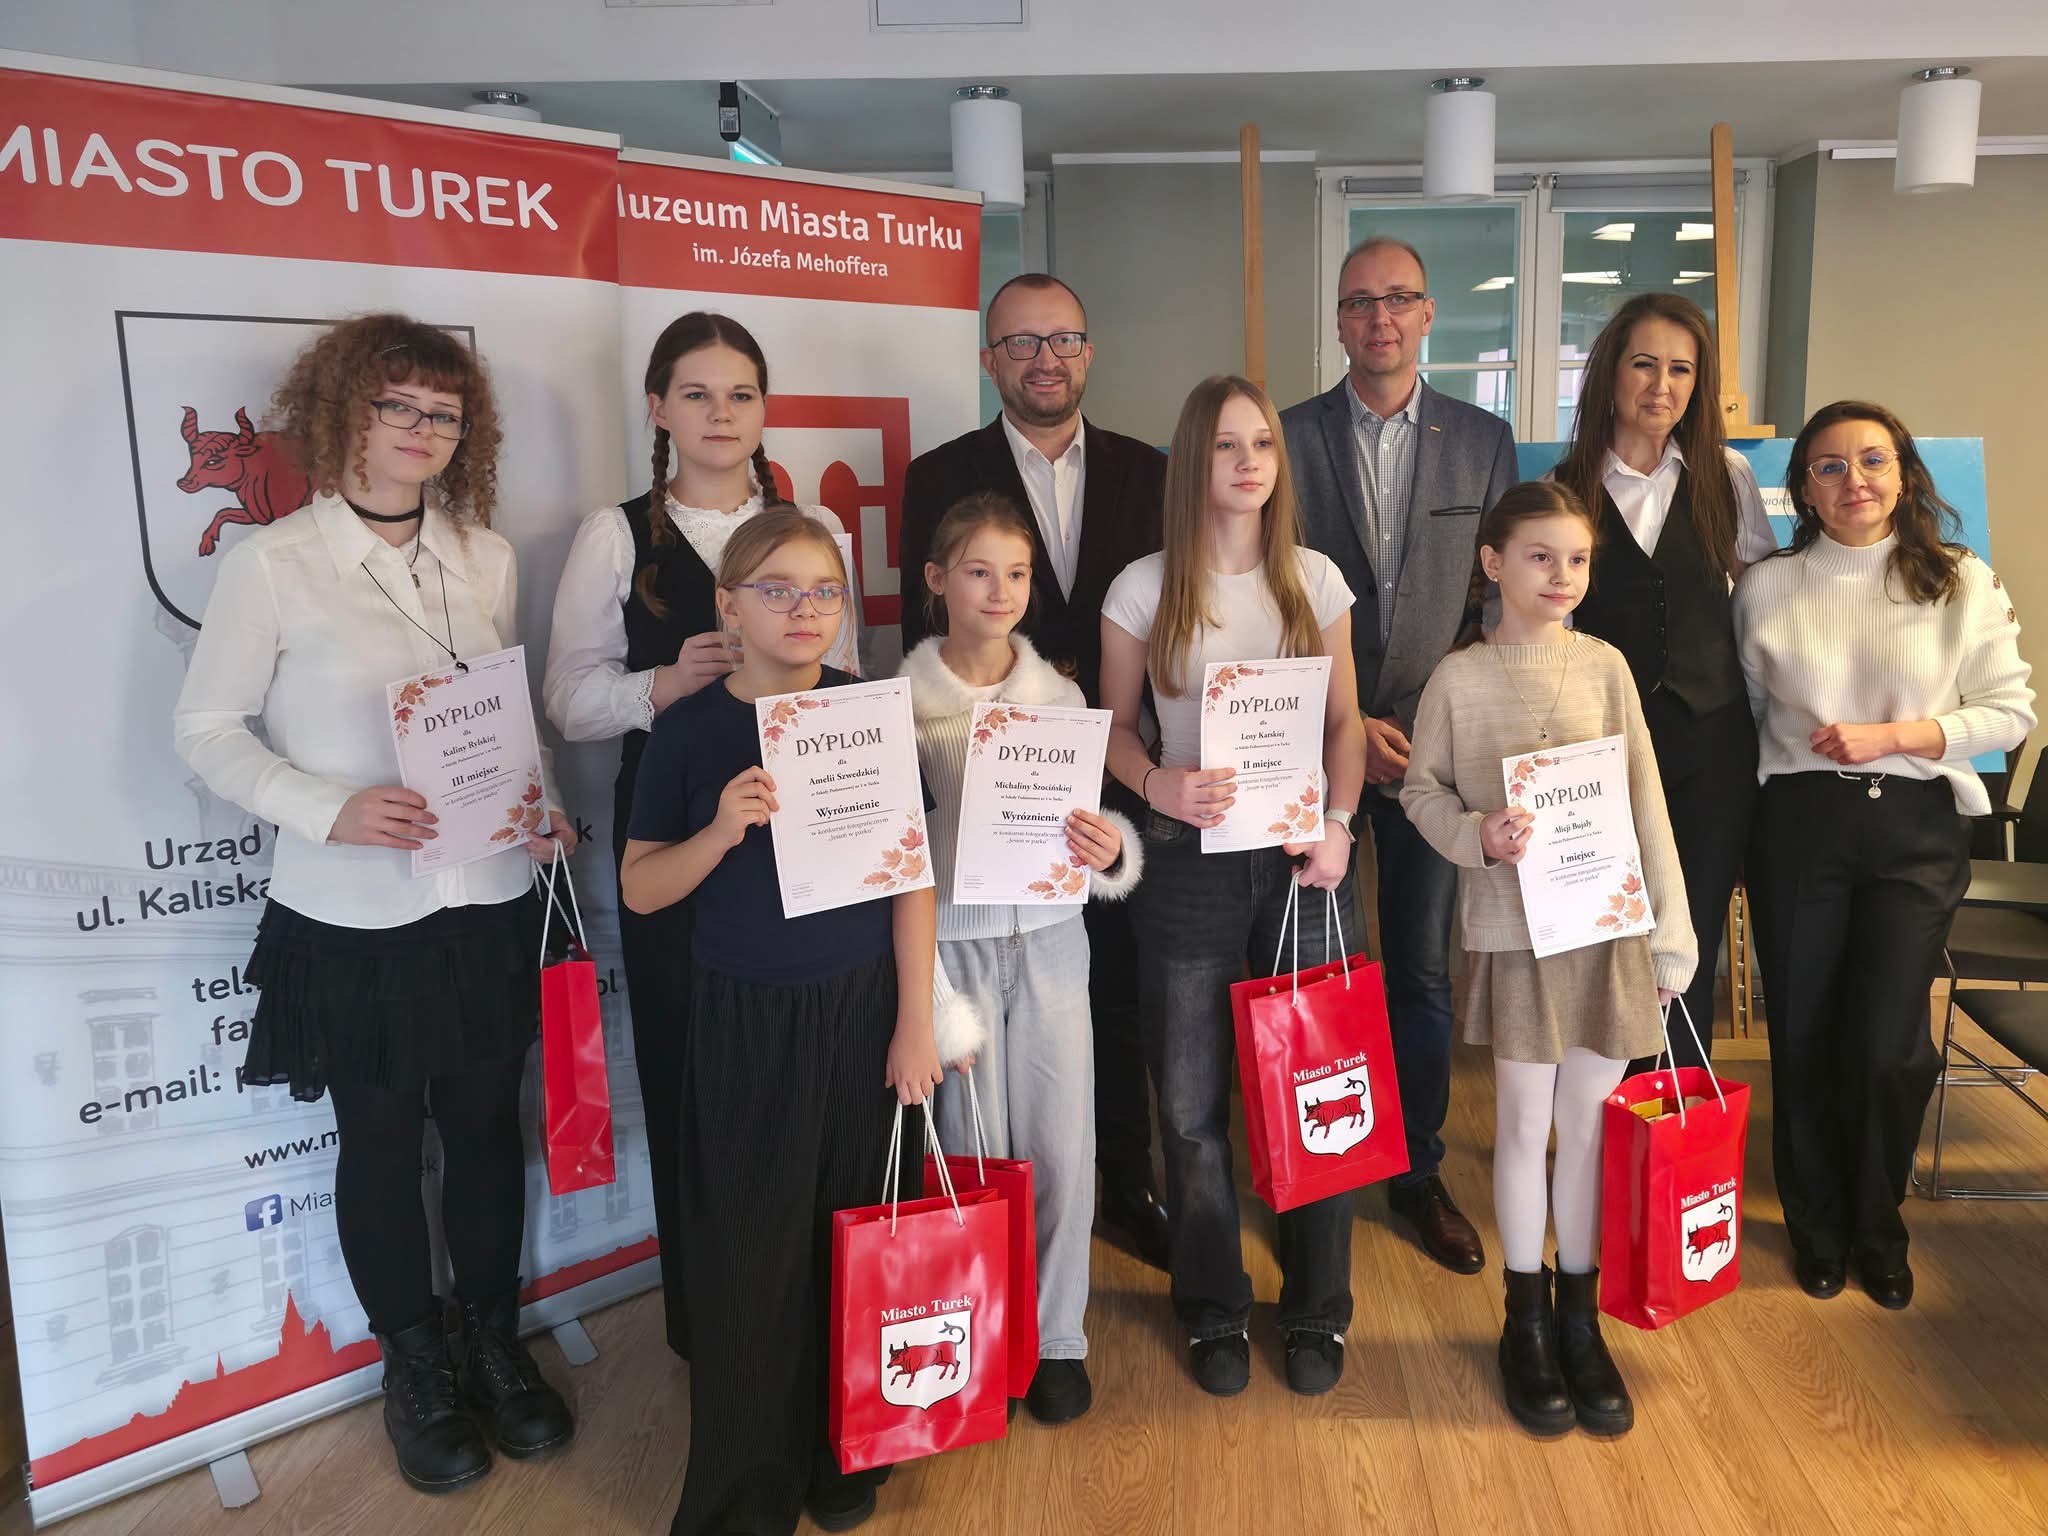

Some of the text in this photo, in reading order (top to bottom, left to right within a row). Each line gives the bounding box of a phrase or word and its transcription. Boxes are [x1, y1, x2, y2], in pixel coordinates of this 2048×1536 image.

[325, 158, 558, 232] TUREK
[617, 183, 963, 251] uzeum Miasta Turku
[692, 242, 888, 277] im. Józefa Mehoffera
[423, 695, 502, 733] DYPLOM
[1229, 696, 1299, 715] DYPLOM
[442, 742, 467, 758] Kaliny
[468, 735, 496, 750] Rylskiej
[795, 727, 883, 757] DYPLOM
[1241, 732, 1257, 741] Leny
[837, 758, 847, 766] dla
[998, 744, 1076, 765] DYPLOM
[1243, 758, 1282, 770] II miejsce
[452, 764, 500, 788] III miejsce
[809, 766, 880, 786] Amelii Szwedzkiej
[994, 781, 1031, 792] Michaliny
[1534, 781, 1603, 810] DYPLOM
[1554, 823, 1571, 834] Alicji
[144, 823, 262, 870] Urząd
[1560, 849, 1596, 864] I miejsce
[76, 895, 125, 932] ul.
[192, 965, 253, 1003] tel.
[211, 1015, 253, 1046] fa
[1293, 1052, 1367, 1083] Miasto Turek
[79, 1063, 222, 1124] e-mail:
[1680, 1177, 1736, 1210] Miasto Turek
[880, 1295, 972, 1323] Miasto Turek
